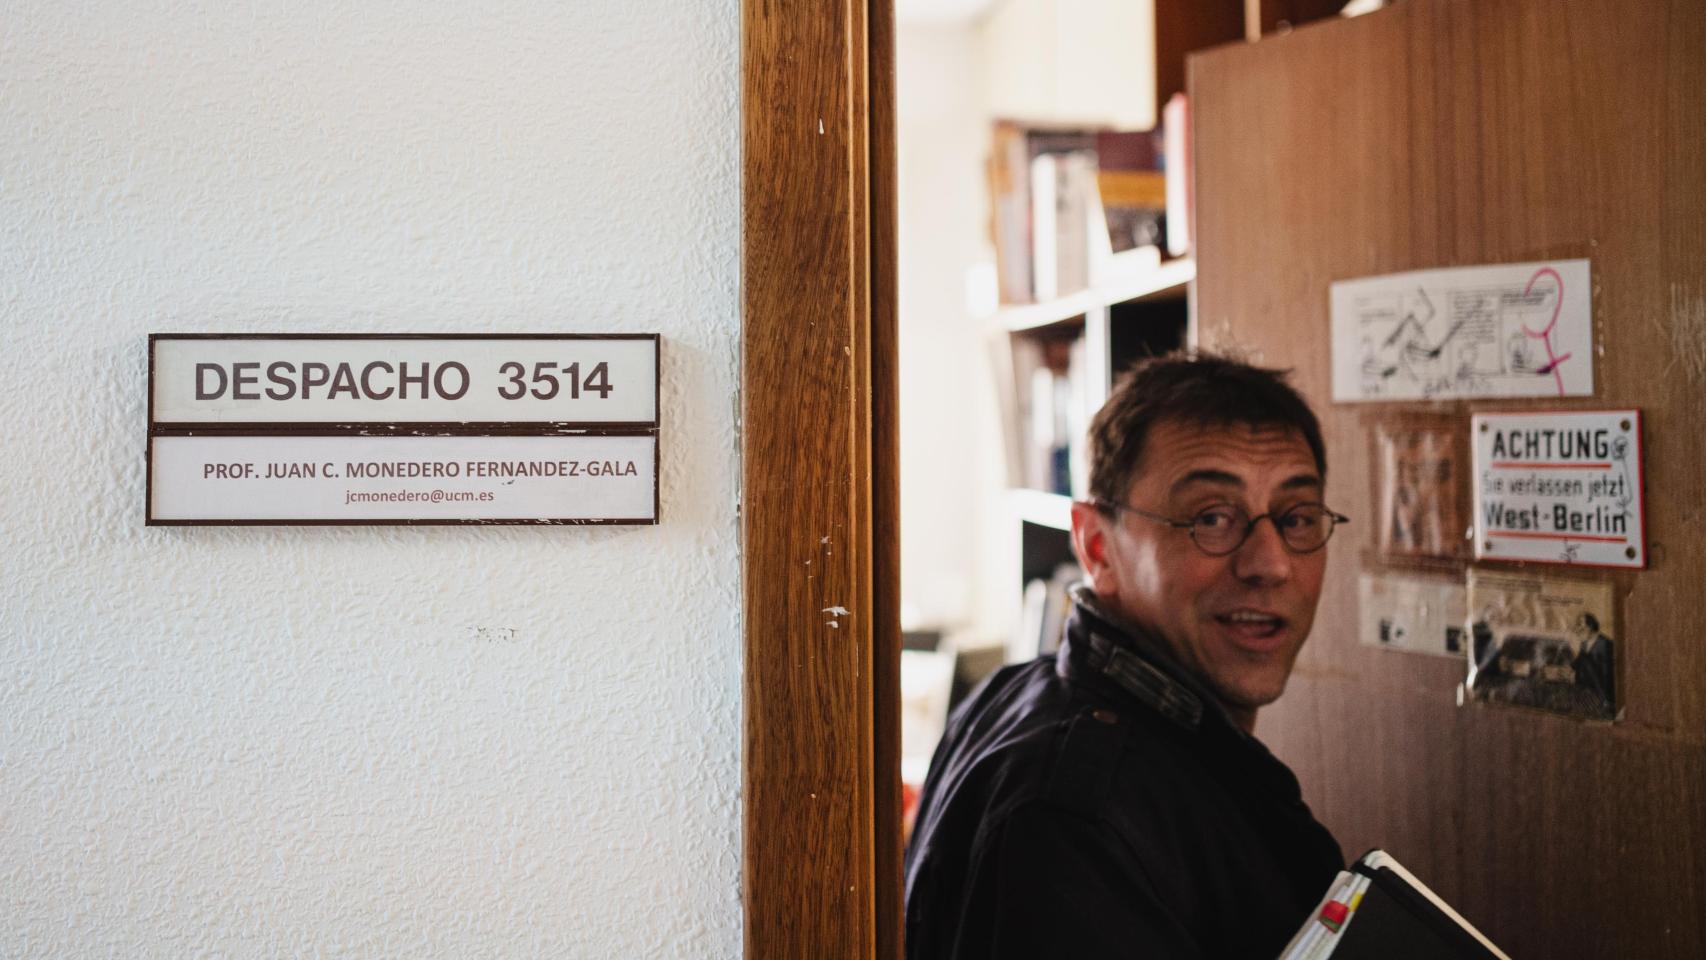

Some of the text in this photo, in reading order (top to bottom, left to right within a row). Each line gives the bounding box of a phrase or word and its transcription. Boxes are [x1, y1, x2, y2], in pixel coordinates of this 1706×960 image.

[195, 361, 614, 401] DESPACHO 3514
[1492, 428, 1609, 459] ACHTUNG
[203, 460, 638, 479] PROF. JUAN C. MONEDERO FERNANDEZ-GALA
[345, 488, 495, 504] jcmonedero@ucm.es
[1483, 471, 1624, 502] Sie verlassen jetzt
[1485, 501, 1626, 534] West-Berlin
